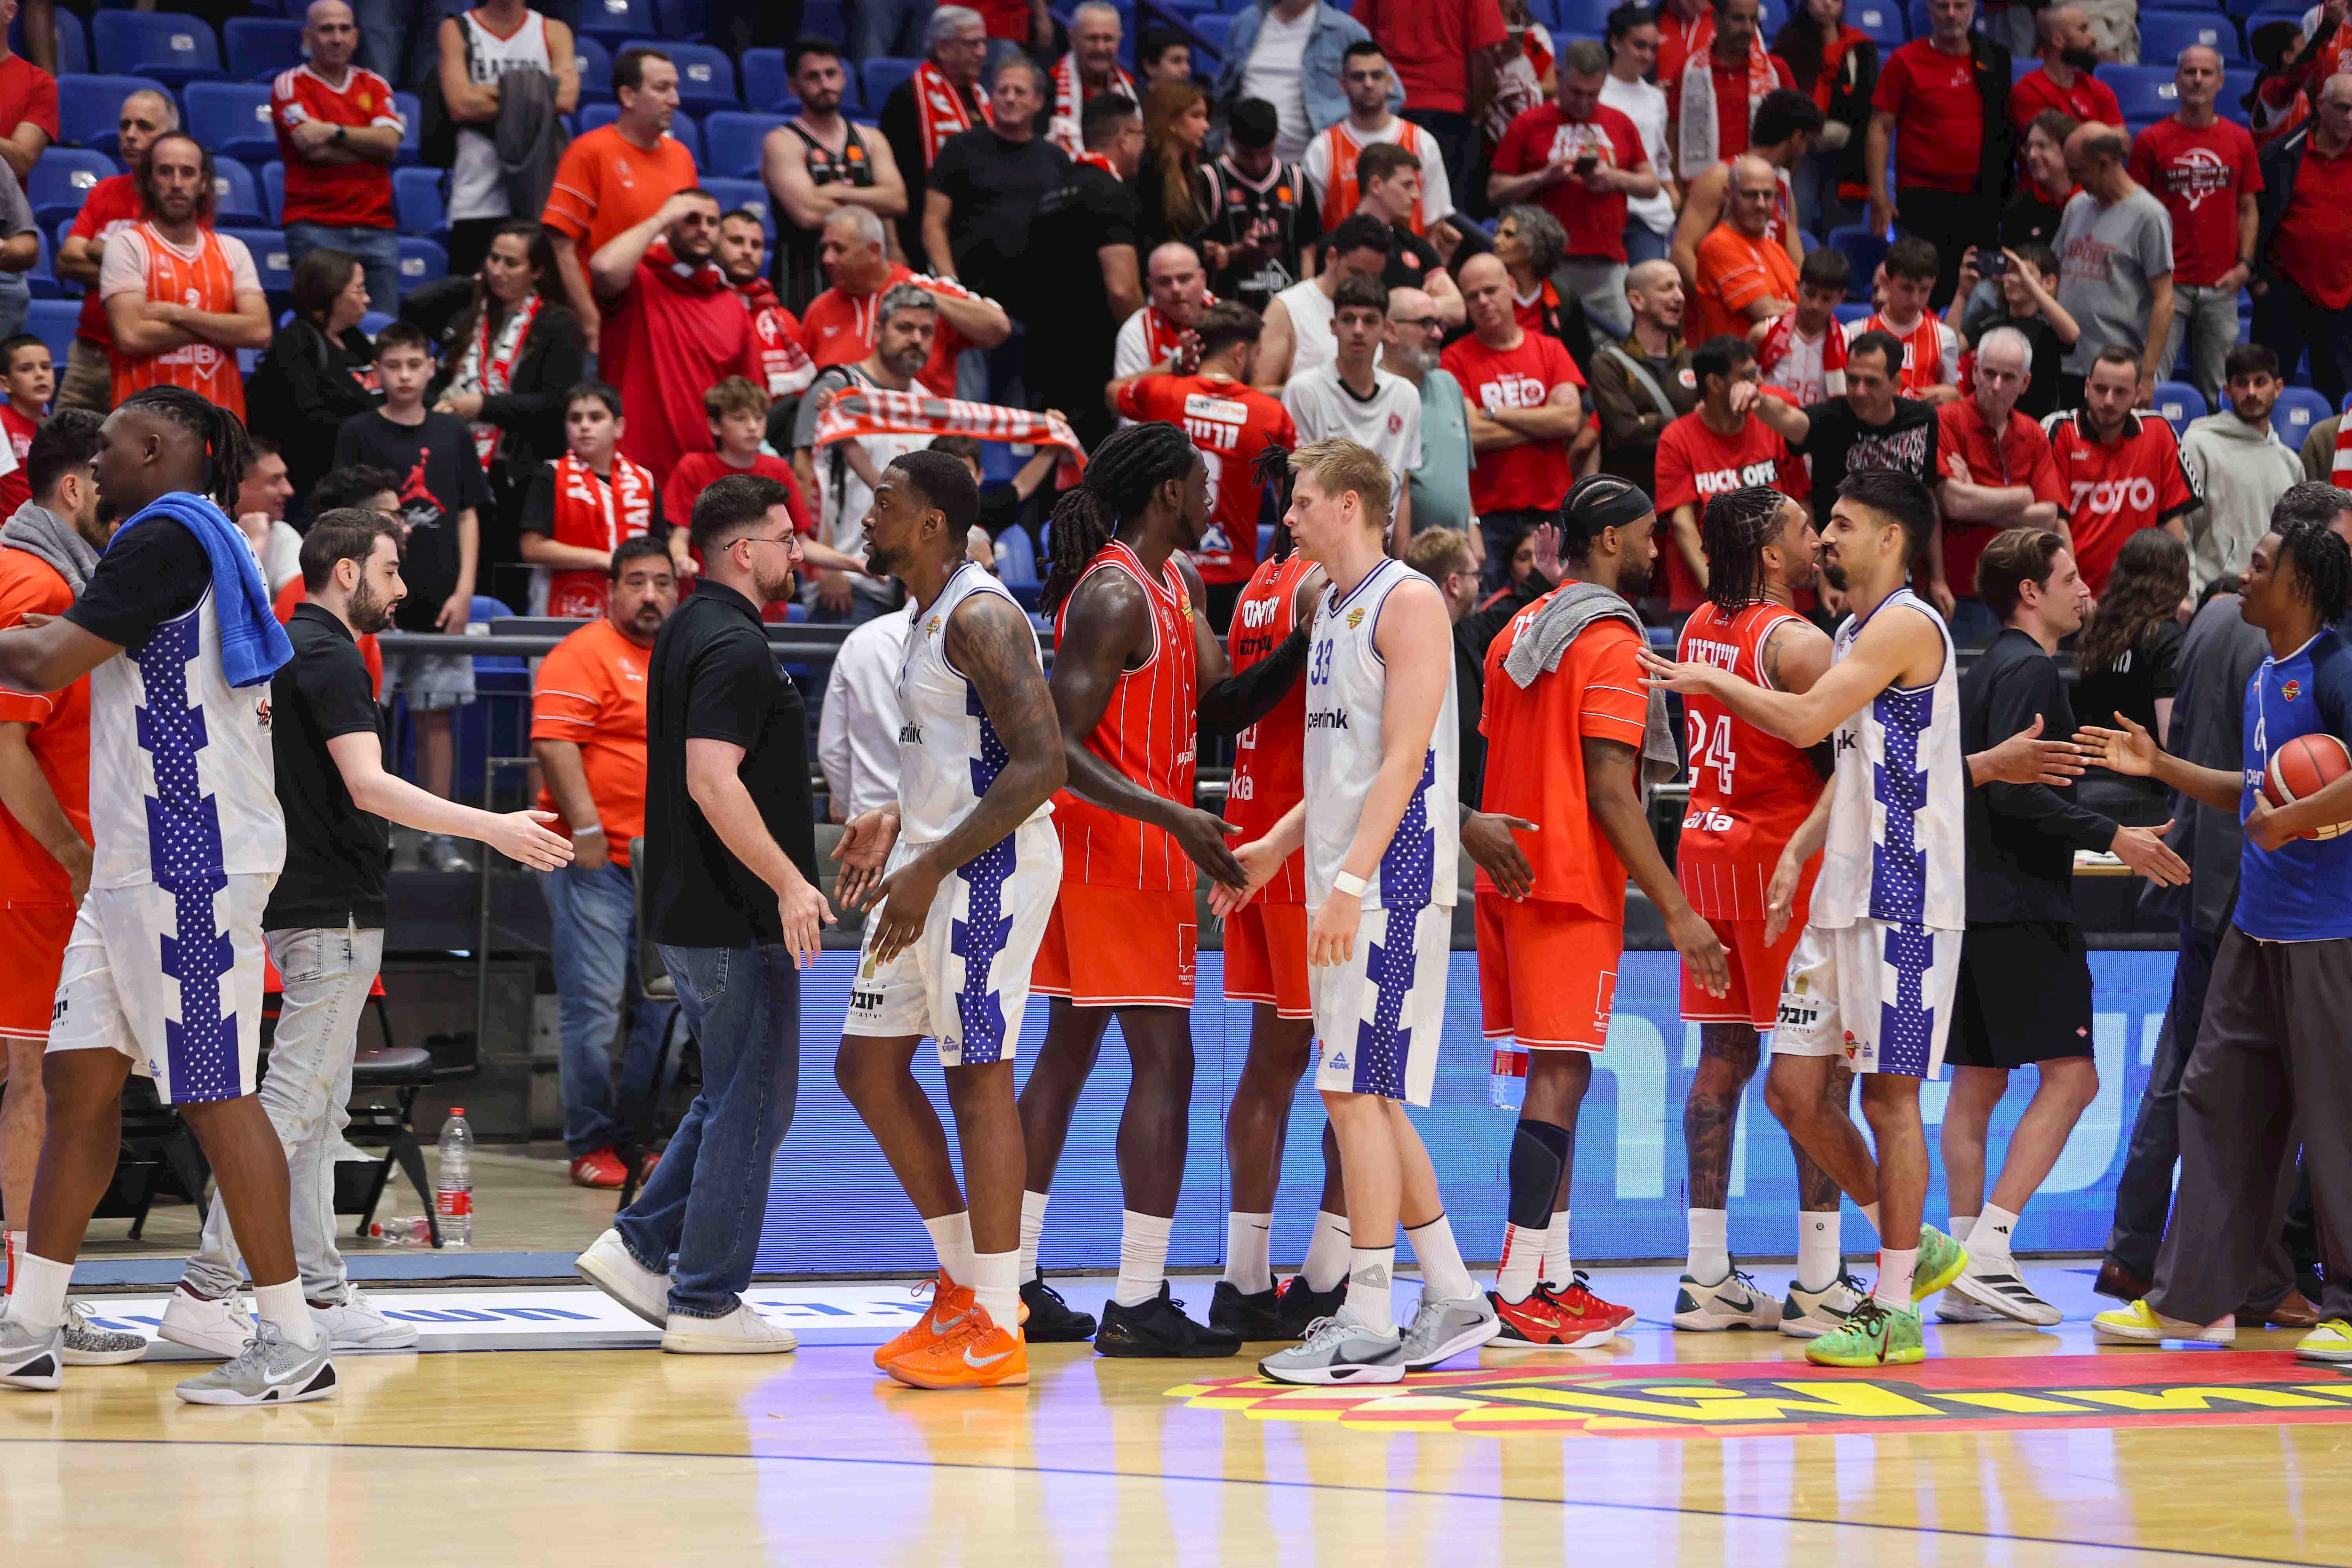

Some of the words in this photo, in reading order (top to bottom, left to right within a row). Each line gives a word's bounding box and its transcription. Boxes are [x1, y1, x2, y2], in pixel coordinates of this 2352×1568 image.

[1480, 378, 1545, 408] RED
[866, 389, 932, 430] TEL
[1695, 469, 1741, 493] FUCK
[2069, 477, 2155, 515] TOTO
[1311, 638, 1333, 685] 33
[1688, 709, 1736, 795] 24
[2247, 769, 2264, 787] pen
[850, 987, 883, 1010] יובל
[942, 1043, 960, 1052] PEAK
[1329, 1061, 1350, 1070] PEAK
